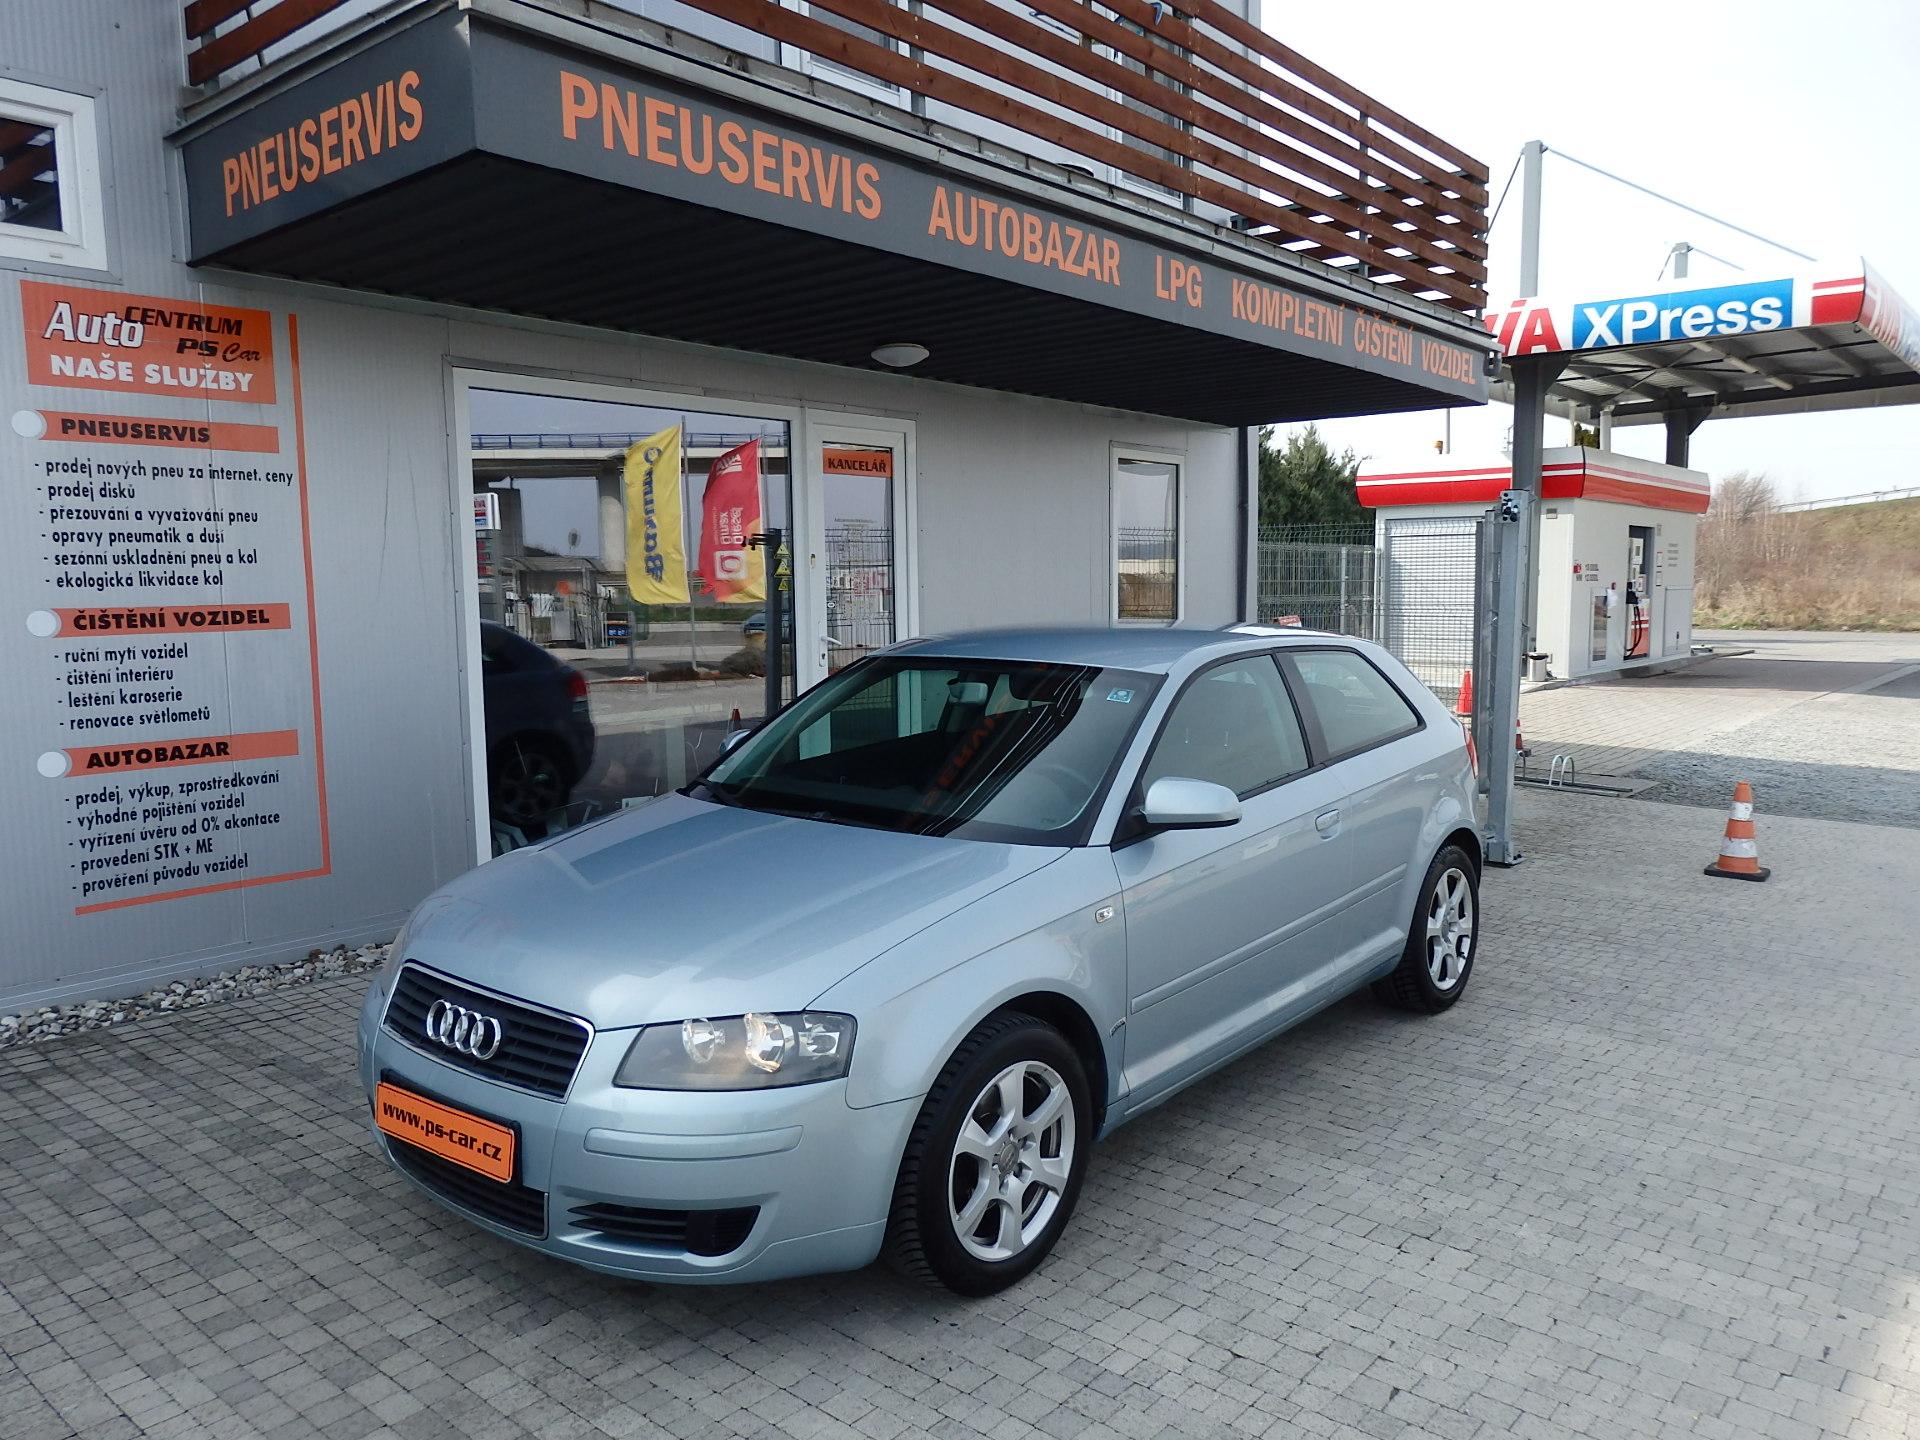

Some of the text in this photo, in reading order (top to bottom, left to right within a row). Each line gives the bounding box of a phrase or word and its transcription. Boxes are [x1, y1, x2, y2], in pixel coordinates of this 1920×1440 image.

[222, 70, 424, 217] PNEUSERVIS
[559, 70, 1476, 385] PNEUSERVIS AUTOBAZAR LPG KOMPLETNÍ ČIŠTĚNÍ VOZIDEL
[42, 301, 242, 348] Auto CENTRUM
[1582, 296, 1783, 348] XPress
[176, 338, 262, 363] PS Car
[51, 352, 253, 392] NAŠE SLUŽBY
[61, 419, 210, 443] PNEUSERVIS
[46, 458, 293, 486] prodej nových pneu za internet. ceny
[827, 458, 887, 473] KANCELÁŘ
[48, 482, 135, 501] prodej disků
[50, 506, 258, 525] přezouvání a vyvažování pneu
[52, 531, 103, 546] opravy
[108, 527, 181, 546] pneumatik
[186, 533, 194, 543] a
[54, 548, 258, 568] sezónní uskladnění pneu a kol
[57, 570, 224, 591] ekologická likvidace kol
[73, 608, 270, 630] ČIŠTĚNÍ VOZIDEL
[65, 642, 188, 664] ruční mytí vozidel
[67, 666, 174, 685] čištění interiéru
[68, 686, 183, 708] leštění karoserie
[70, 706, 210, 730] renovace světlometů
[87, 742, 229, 768] AUTOBAZAR
[76, 770, 279, 809] prodej, výkup, zprostředkování
[78, 792, 245, 830] výhodné pojištění vozidel
[79, 812, 280, 852] vyřízení úvěru od 0% akontace
[81, 850, 150, 875] provedení
[154, 843, 179, 861] STK
[196, 838, 213, 855] ME
[83, 853, 248, 897] prověření původu vozidel
[383, 1102, 502, 1162] www.ps-car.cz
